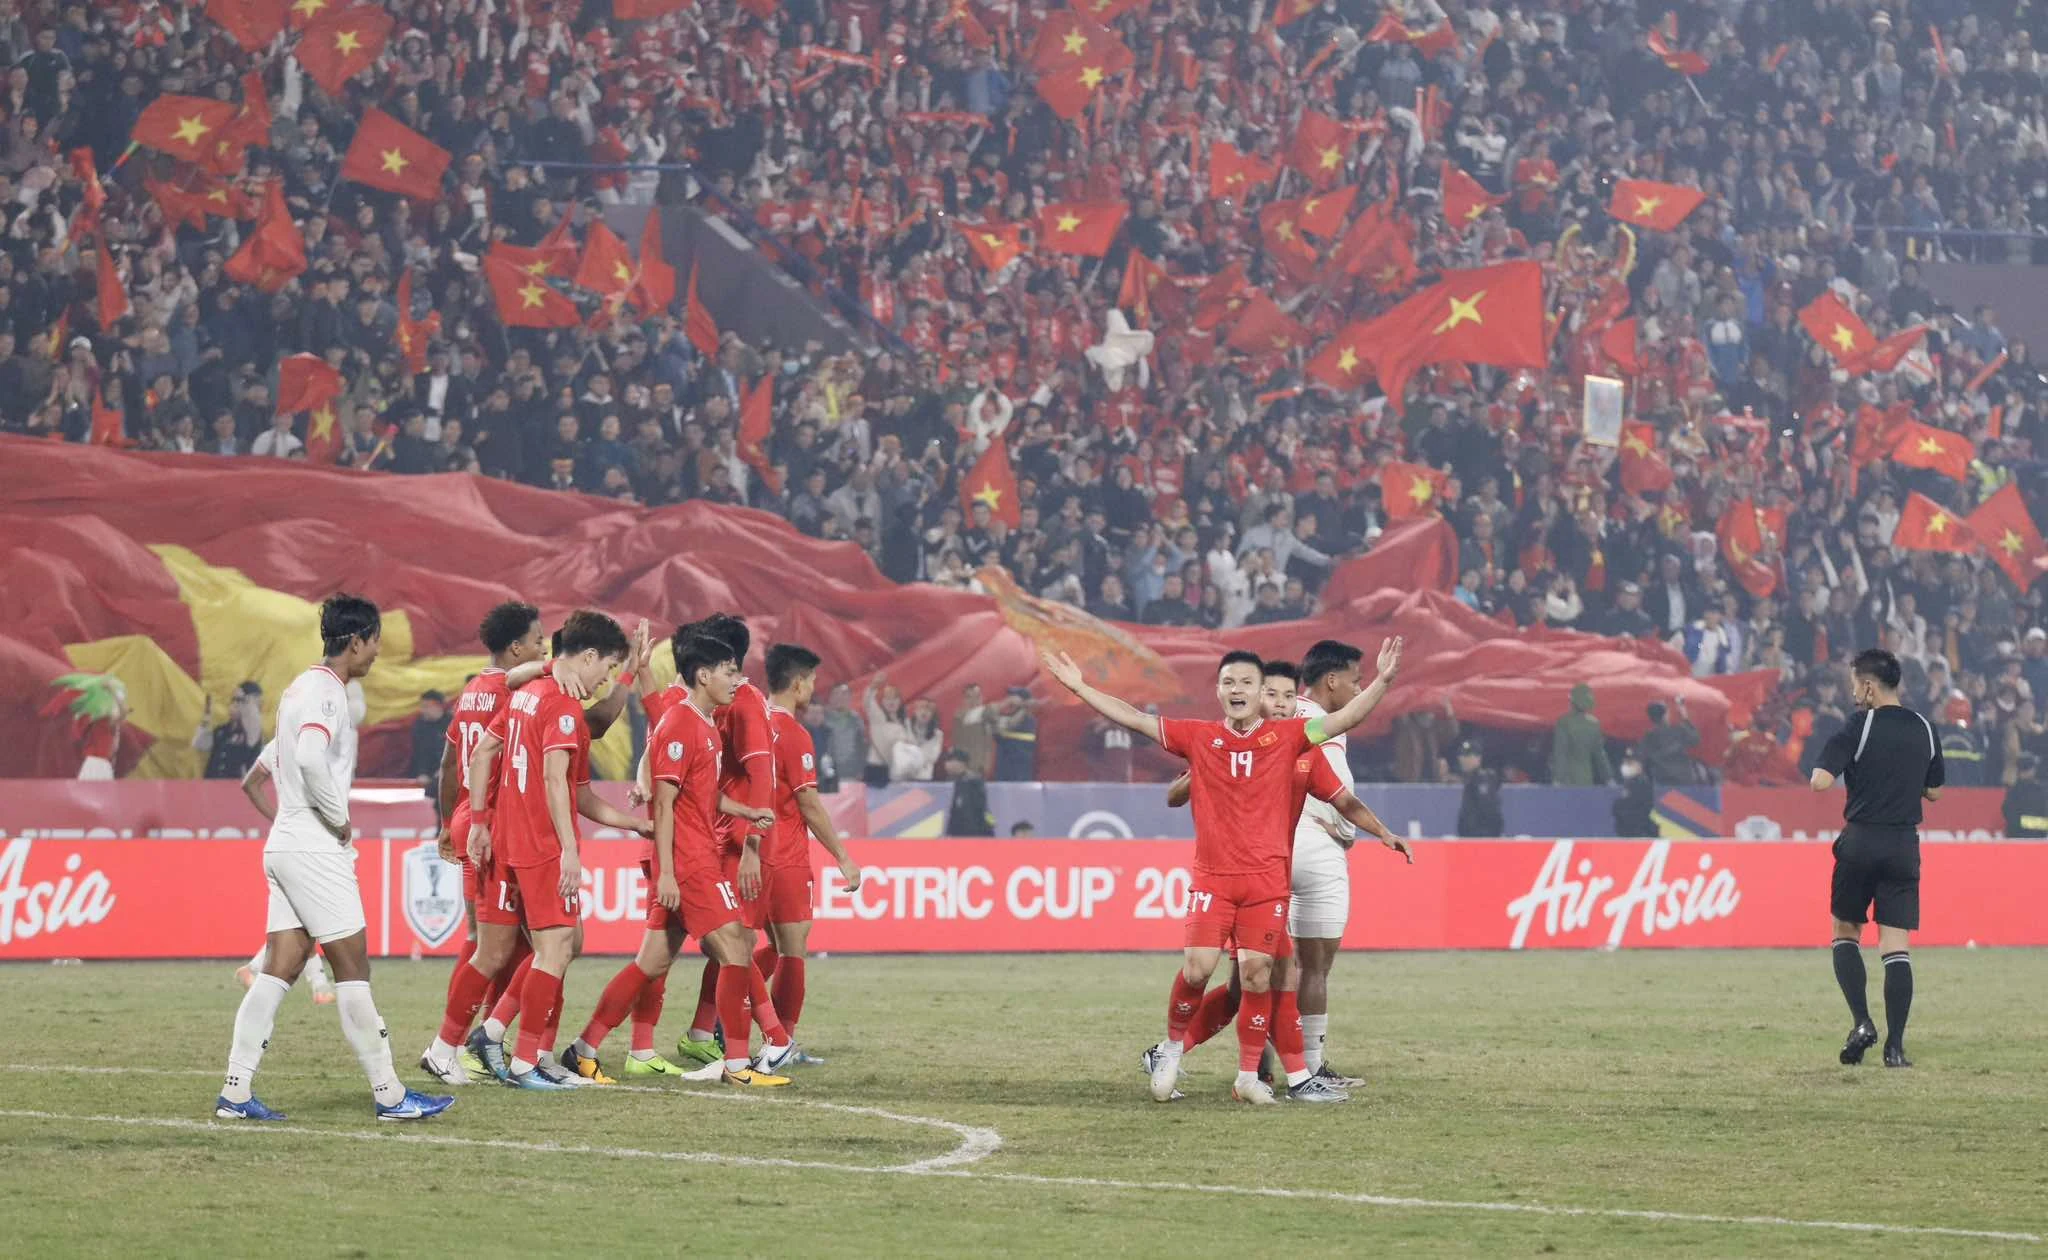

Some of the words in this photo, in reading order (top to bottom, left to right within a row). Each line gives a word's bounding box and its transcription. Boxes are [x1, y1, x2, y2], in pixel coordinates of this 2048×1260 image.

[1229, 750, 1253, 778] 19
[0, 838, 116, 945] Asia
[812, 866, 994, 921] ECTRIC
[1005, 865, 1116, 921] CUP
[1133, 867, 1192, 920] 20
